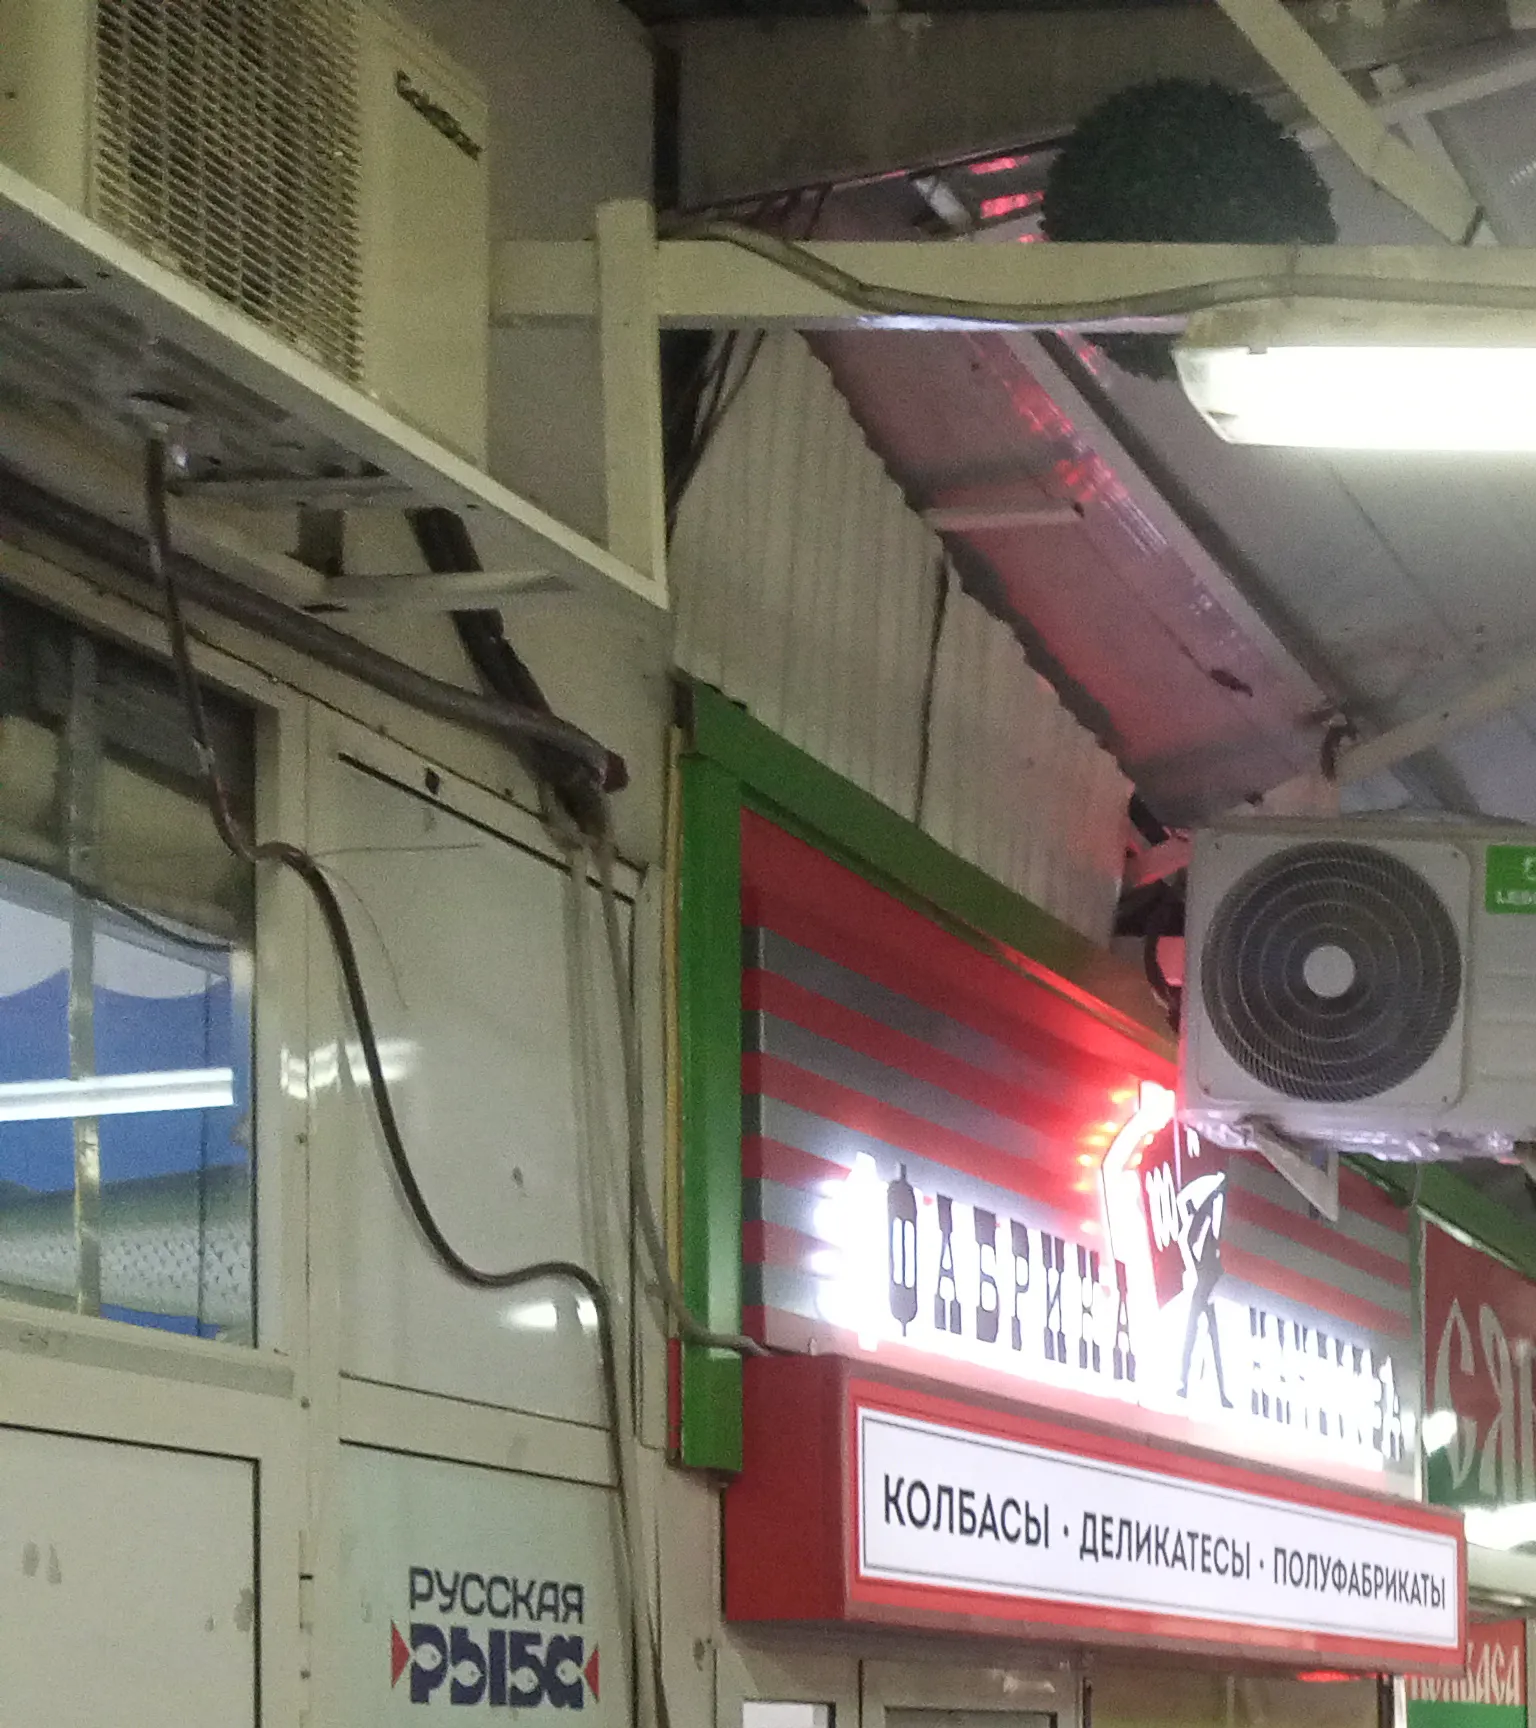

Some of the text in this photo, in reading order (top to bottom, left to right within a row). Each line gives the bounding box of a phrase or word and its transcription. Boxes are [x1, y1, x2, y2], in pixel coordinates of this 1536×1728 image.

[885, 1163, 1137, 1382] ФАБРИКА
[409, 1565, 584, 1624] РУССКАЯ
[883, 1474, 1446, 1611] КОЛБАСЫ ДЕЛИКАТЕСЫ ПОЛУФАБРИКАТЫ
